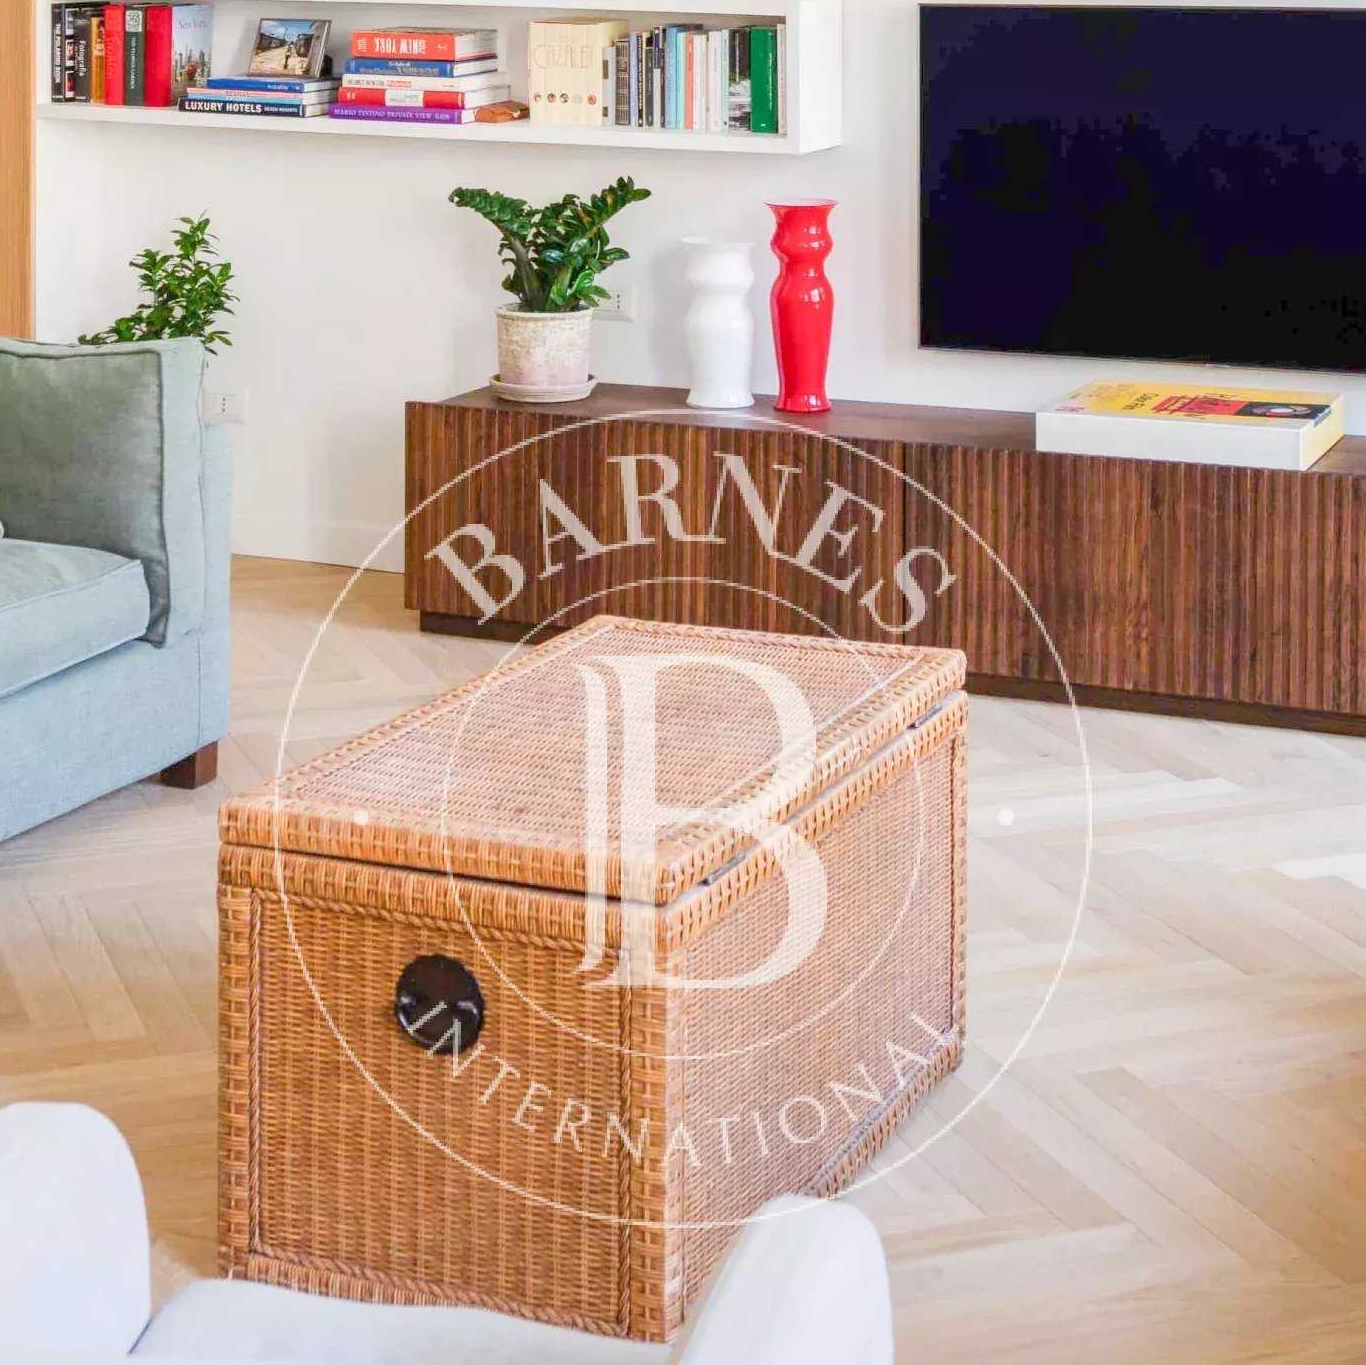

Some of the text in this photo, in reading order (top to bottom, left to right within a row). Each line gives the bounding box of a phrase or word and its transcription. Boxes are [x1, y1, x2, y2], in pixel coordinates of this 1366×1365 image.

[178, 19, 189, 30] New
[374, 36, 421, 55] NEW YORK
[78, 40, 87, 76] Fotografia
[185, 101, 223, 112] LUXURY
[226, 103, 262, 113] HOTELS
